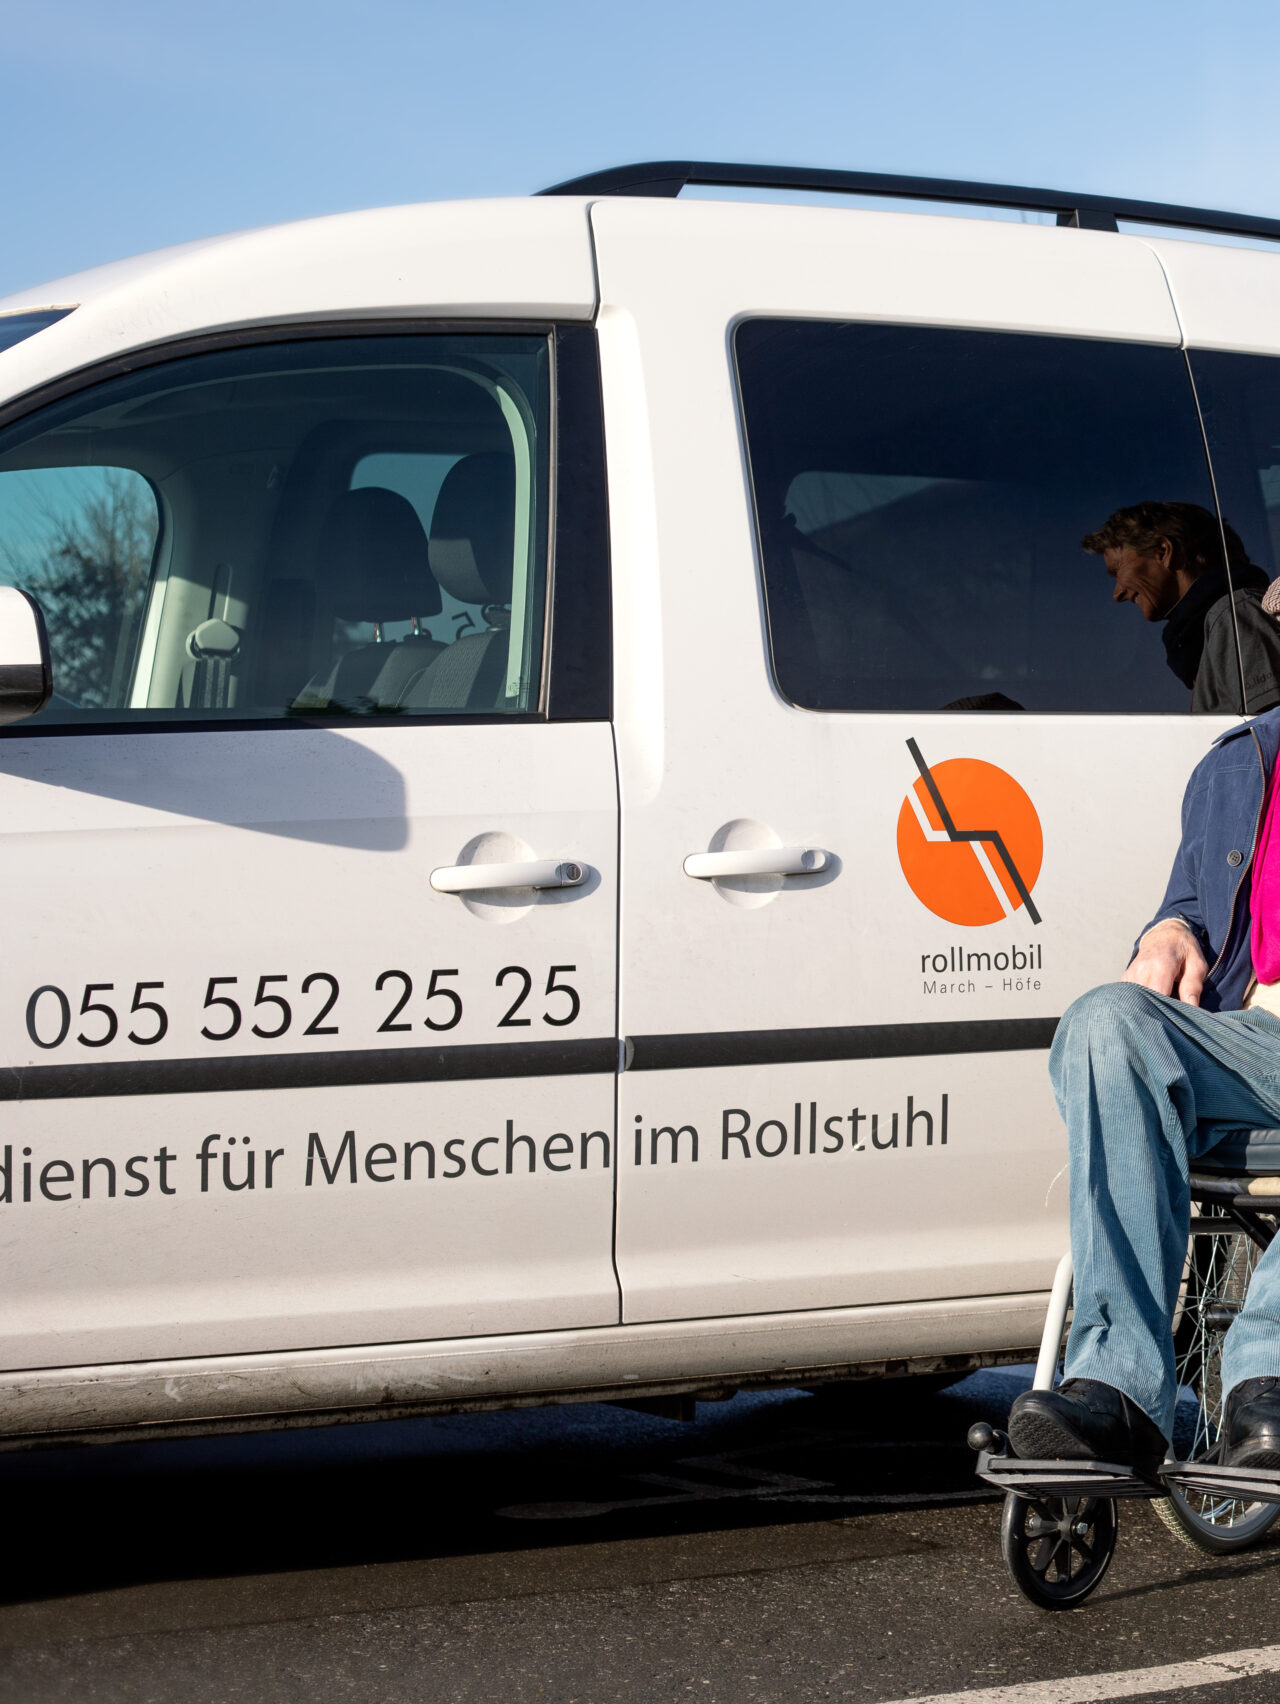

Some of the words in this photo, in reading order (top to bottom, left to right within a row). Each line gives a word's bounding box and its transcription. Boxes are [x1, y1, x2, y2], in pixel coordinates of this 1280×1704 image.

[922, 944, 1041, 972] rollmobil
[924, 980, 974, 993] March
[1003, 978, 1040, 990] Höfe
[26, 982, 168, 1049] 055
[201, 973, 339, 1040] 552
[376, 969, 462, 1032] 25
[496, 965, 580, 1027] 25
[196, 1134, 284, 1192] für
[306, 1120, 609, 1186] Menschen
[635, 1115, 698, 1165] im
[722, 1094, 948, 1159] Rollstuhl
